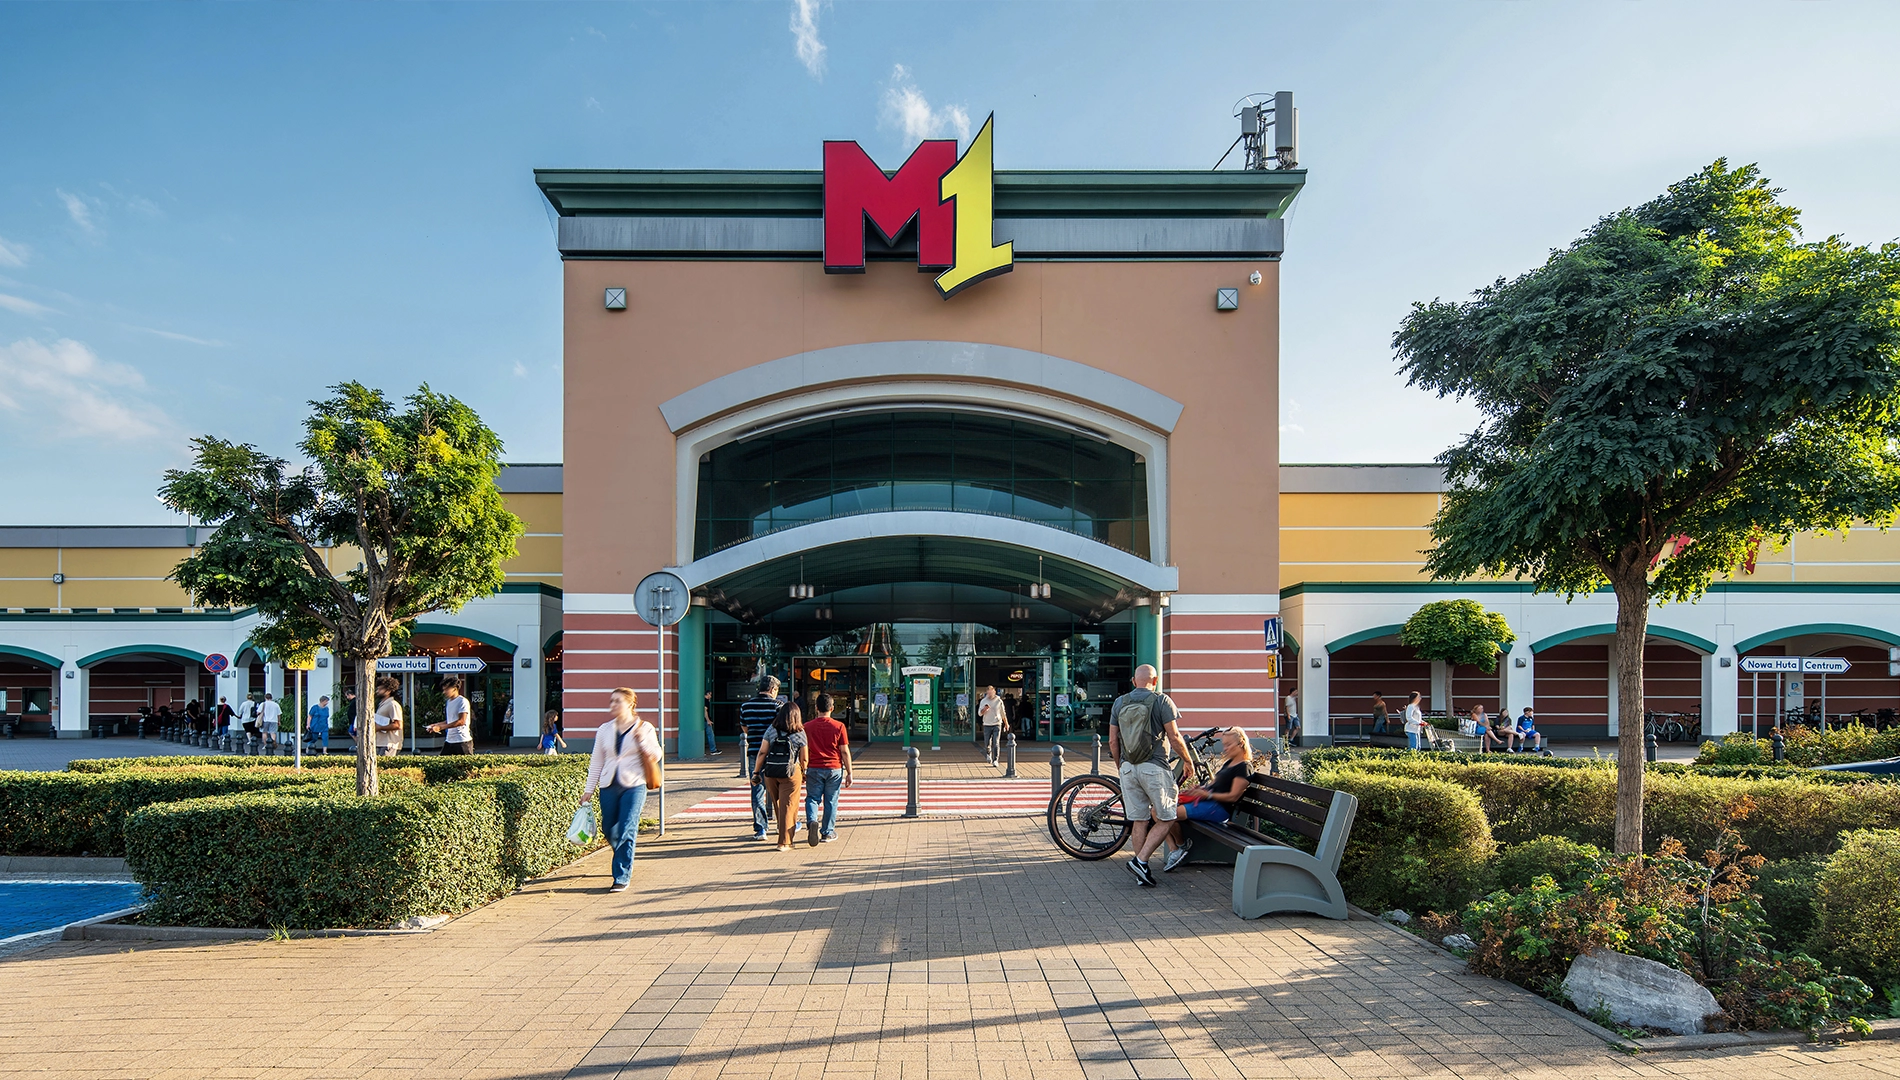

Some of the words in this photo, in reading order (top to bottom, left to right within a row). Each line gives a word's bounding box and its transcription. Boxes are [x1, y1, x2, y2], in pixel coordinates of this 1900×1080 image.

[823, 110, 1014, 301] M1
[377, 661, 402, 669] Nowa
[405, 660, 427, 669] Huta
[438, 661, 478, 670] Centrum
[1747, 660, 1773, 669] Nowa
[1775, 660, 1797, 669] Huta
[1804, 660, 1843, 670] Centrum
